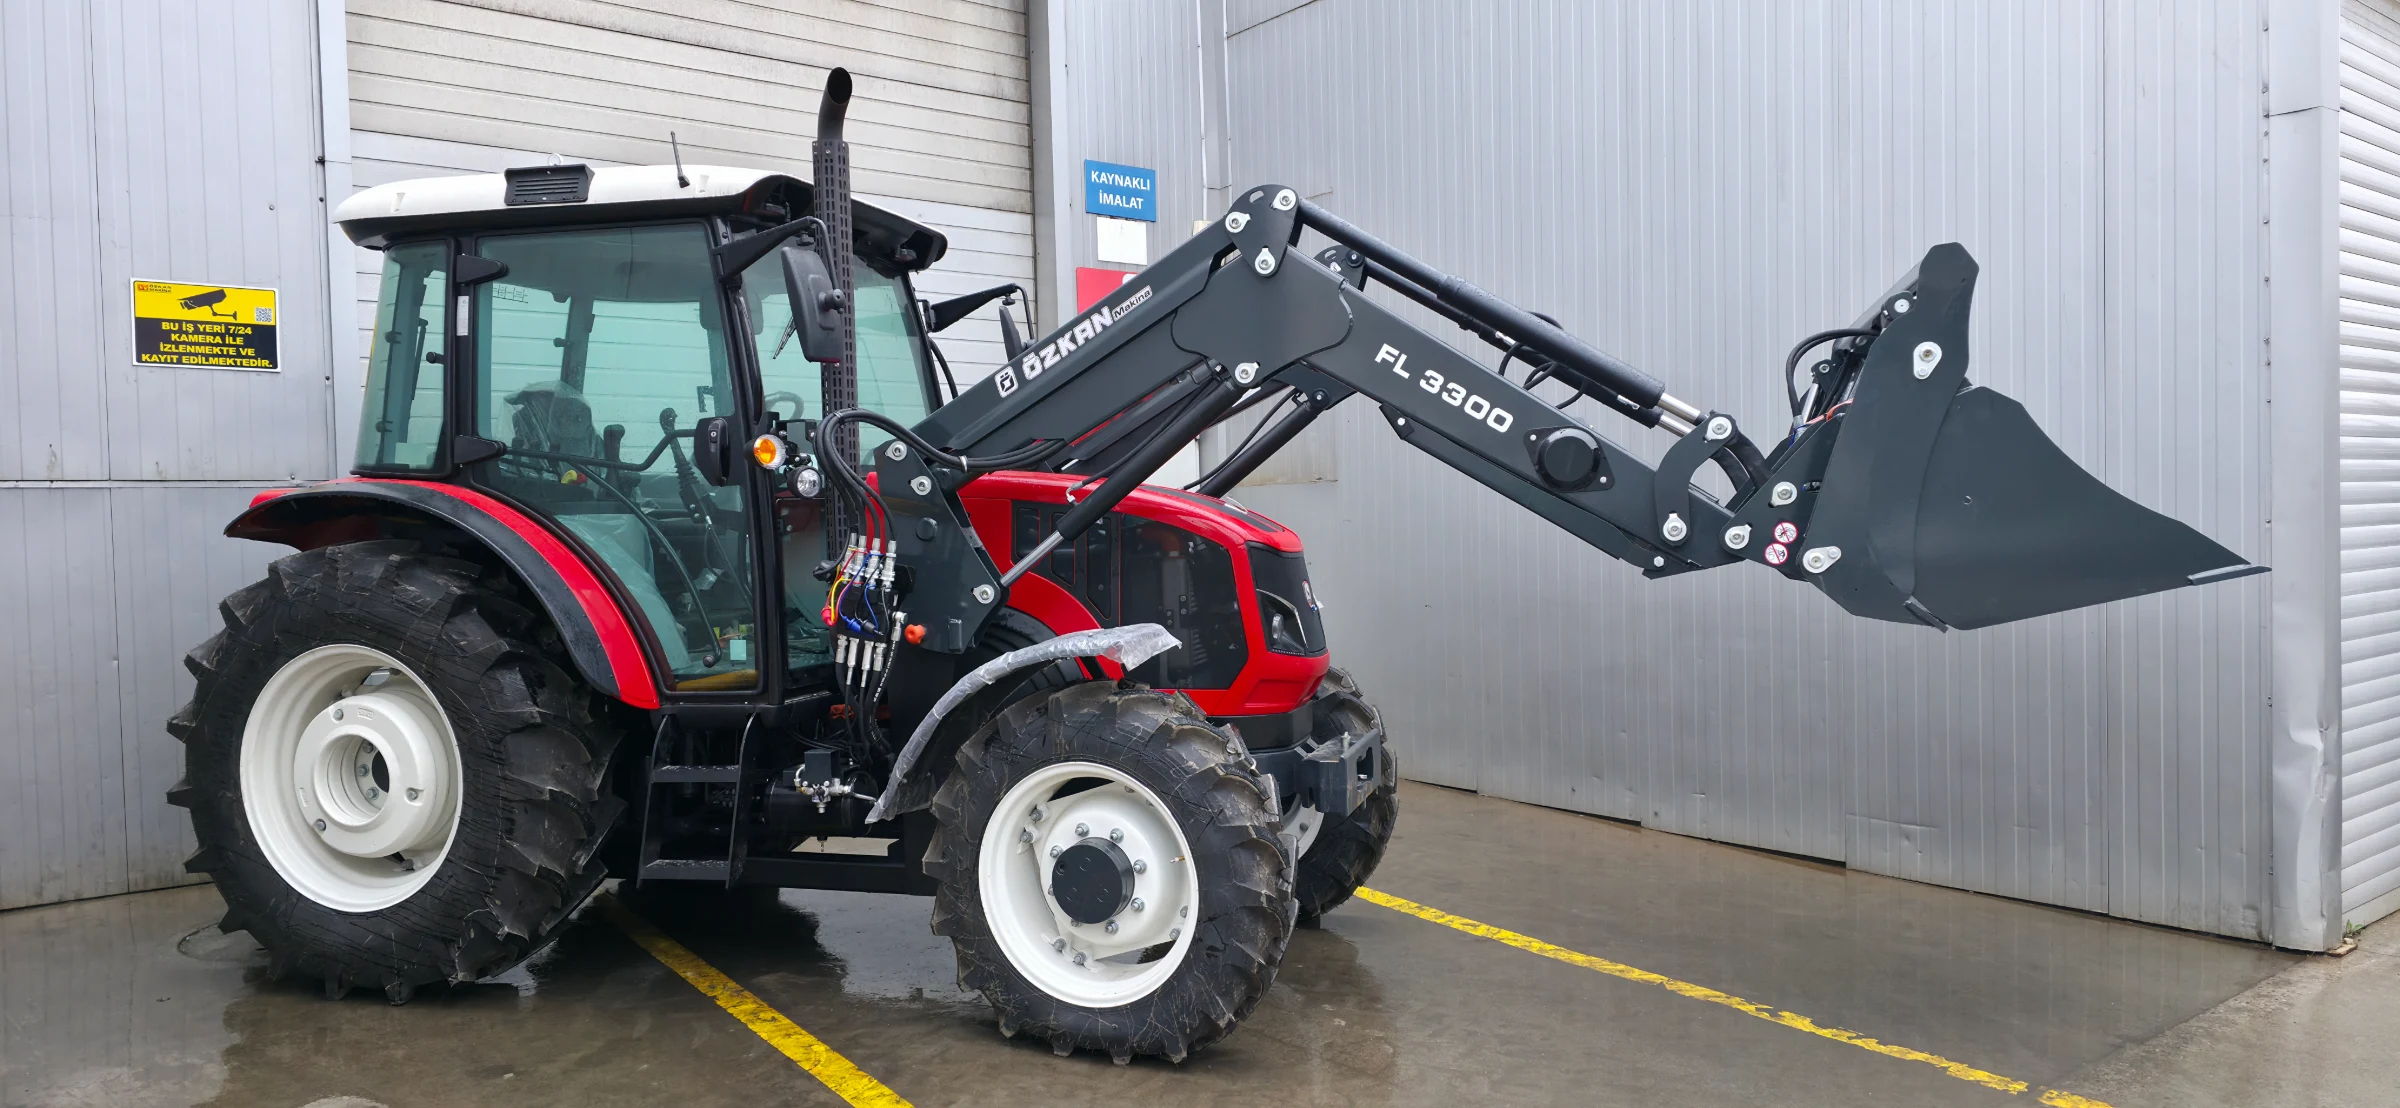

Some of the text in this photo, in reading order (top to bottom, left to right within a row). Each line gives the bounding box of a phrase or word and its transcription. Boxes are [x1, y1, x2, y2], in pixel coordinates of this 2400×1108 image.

[1091, 170, 1150, 191] KAYNAKLI
[1099, 189, 1144, 209] İMALAT
[161, 321, 252, 335] BU İŞ YERİ 7/24
[1022, 305, 1114, 380] ÖZKAN
[1113, 287, 1151, 319] Makina
[171, 333, 244, 345] KAMERA İLE
[159, 341, 256, 356] İZLENMEKTE VE
[141, 353, 273, 368] KAYIT EDİLMEKTEDİR.
[1374, 343, 1514, 433] FL 3300
